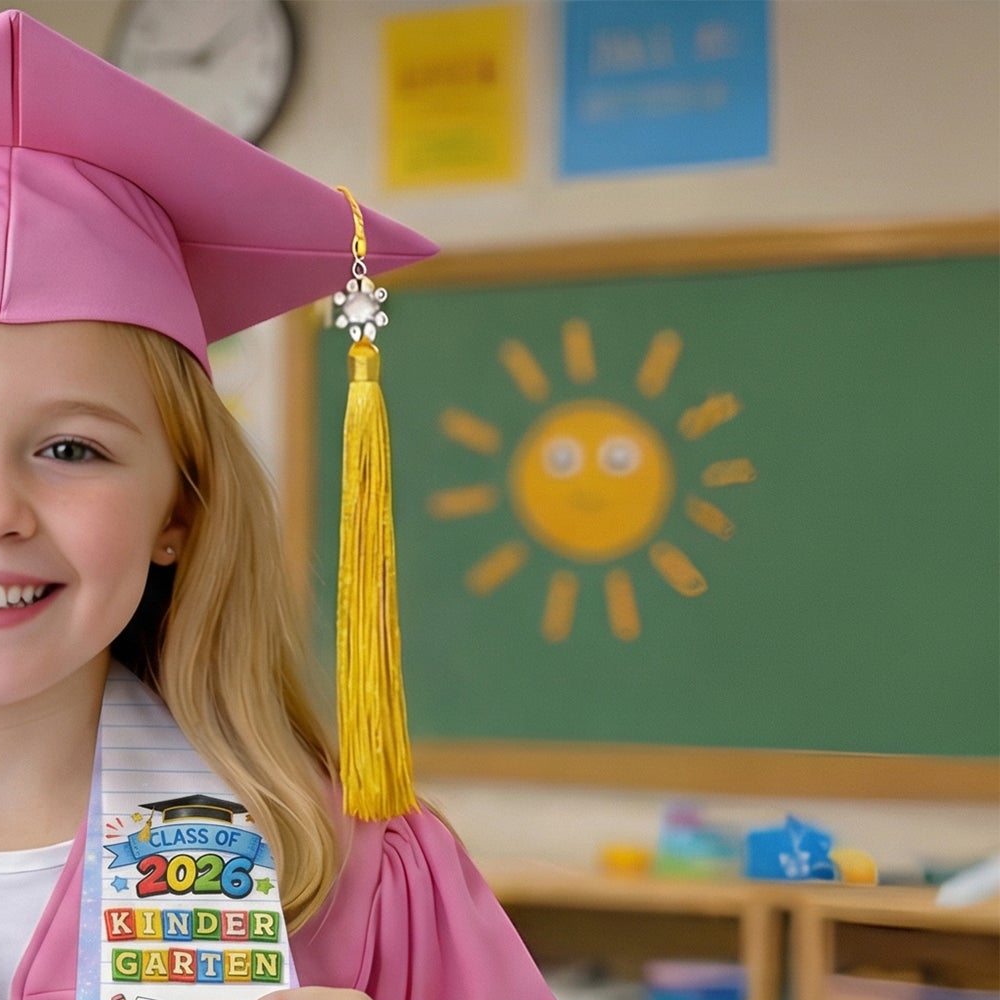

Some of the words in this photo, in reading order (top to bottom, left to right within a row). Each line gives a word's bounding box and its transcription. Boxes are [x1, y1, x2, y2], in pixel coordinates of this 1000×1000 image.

[149, 828, 209, 848] CLASS
[215, 828, 241, 846] OF
[136, 853, 255, 899] 2026
[108, 910, 276, 938] KINDER
[115, 951, 278, 977] GARTEN
